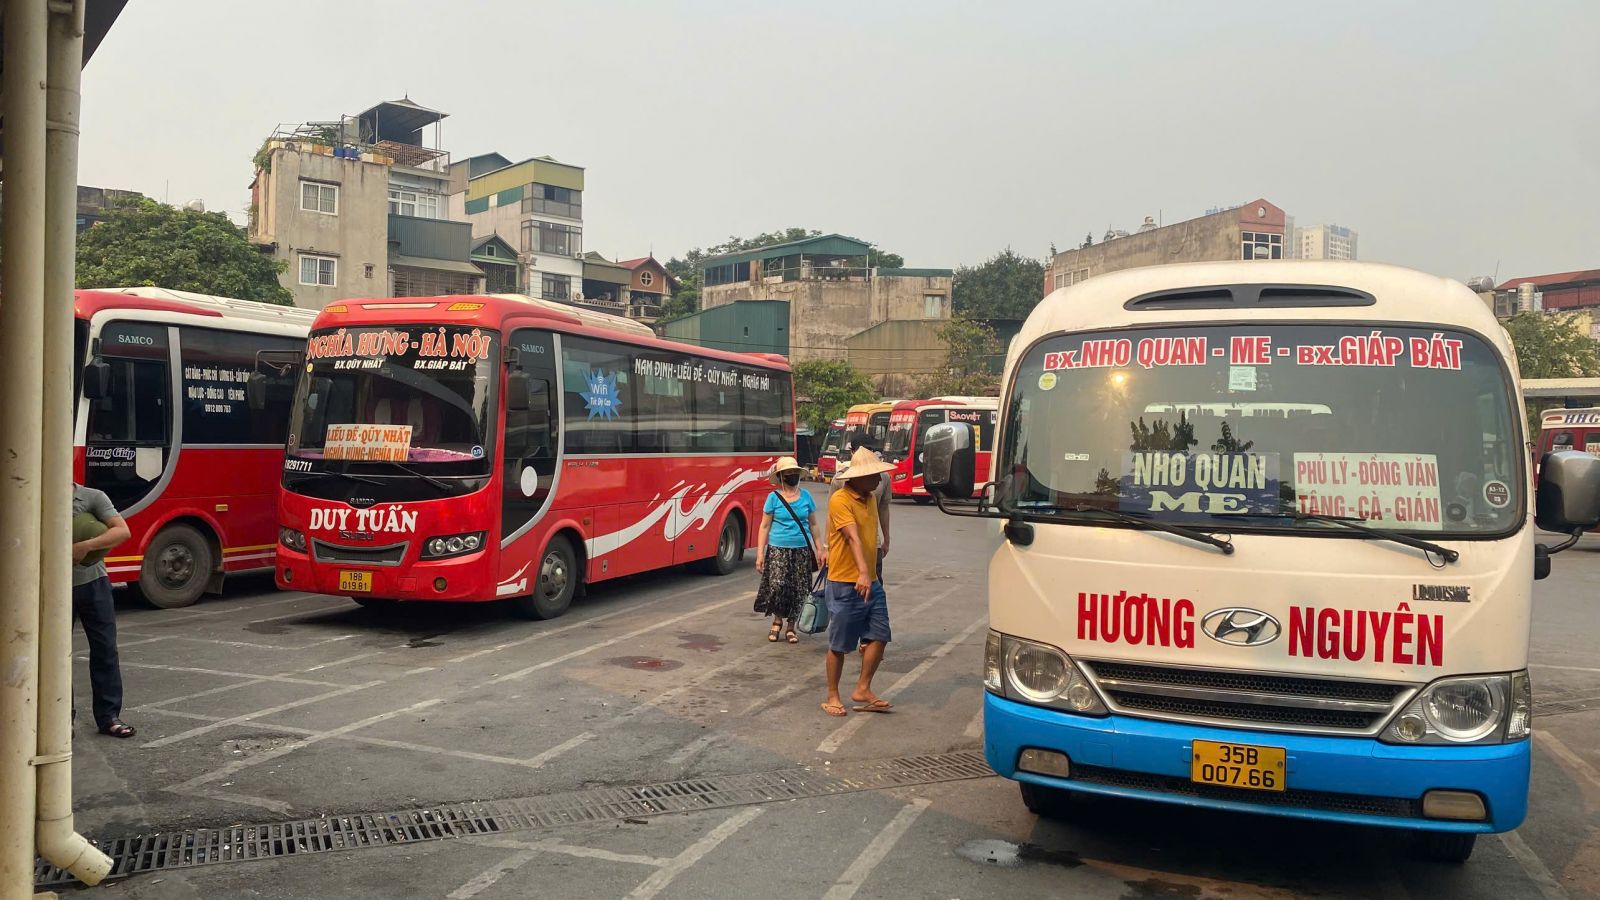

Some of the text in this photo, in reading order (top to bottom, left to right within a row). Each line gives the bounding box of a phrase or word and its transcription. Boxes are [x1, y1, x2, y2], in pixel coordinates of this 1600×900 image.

[118, 334, 153, 345] SAMCO
[306, 328, 353, 360] NGHĨA
[356, 330, 409, 357] HƯNG
[451, 328, 491, 364] NỘI
[521, 343, 545, 354] SAMCO
[1043, 339, 1132, 371] BX.NHO
[1137, 337, 1207, 369] QUAN
[1230, 336, 1271, 365] ME
[1297, 330, 1403, 367] BX.GIÁP
[1410, 332, 1463, 371] BÁT
[413, 358, 469, 371] BX.GIÁP BÁT
[635, 358, 653, 376] NAM
[654, 361, 673, 380] ĐỊNH
[590, 383, 608, 395] Wifi
[1134, 452, 1266, 491] NHO QUAN
[1331, 456, 1348, 484] LÝ
[1359, 454, 1402, 485] ĐỒNG
[1404, 457, 1437, 487] VĂN
[1148, 491, 1249, 514] ME
[1358, 490, 1383, 520] CÀ
[1394, 491, 1440, 523] GIÁN
[309, 504, 418, 534] DUY TUẤN
[1077, 590, 1443, 667] HƯƠNG NGUYÊN
[1219, 745, 1258, 766] 35B
[1202, 764, 1275, 788] 007.66
